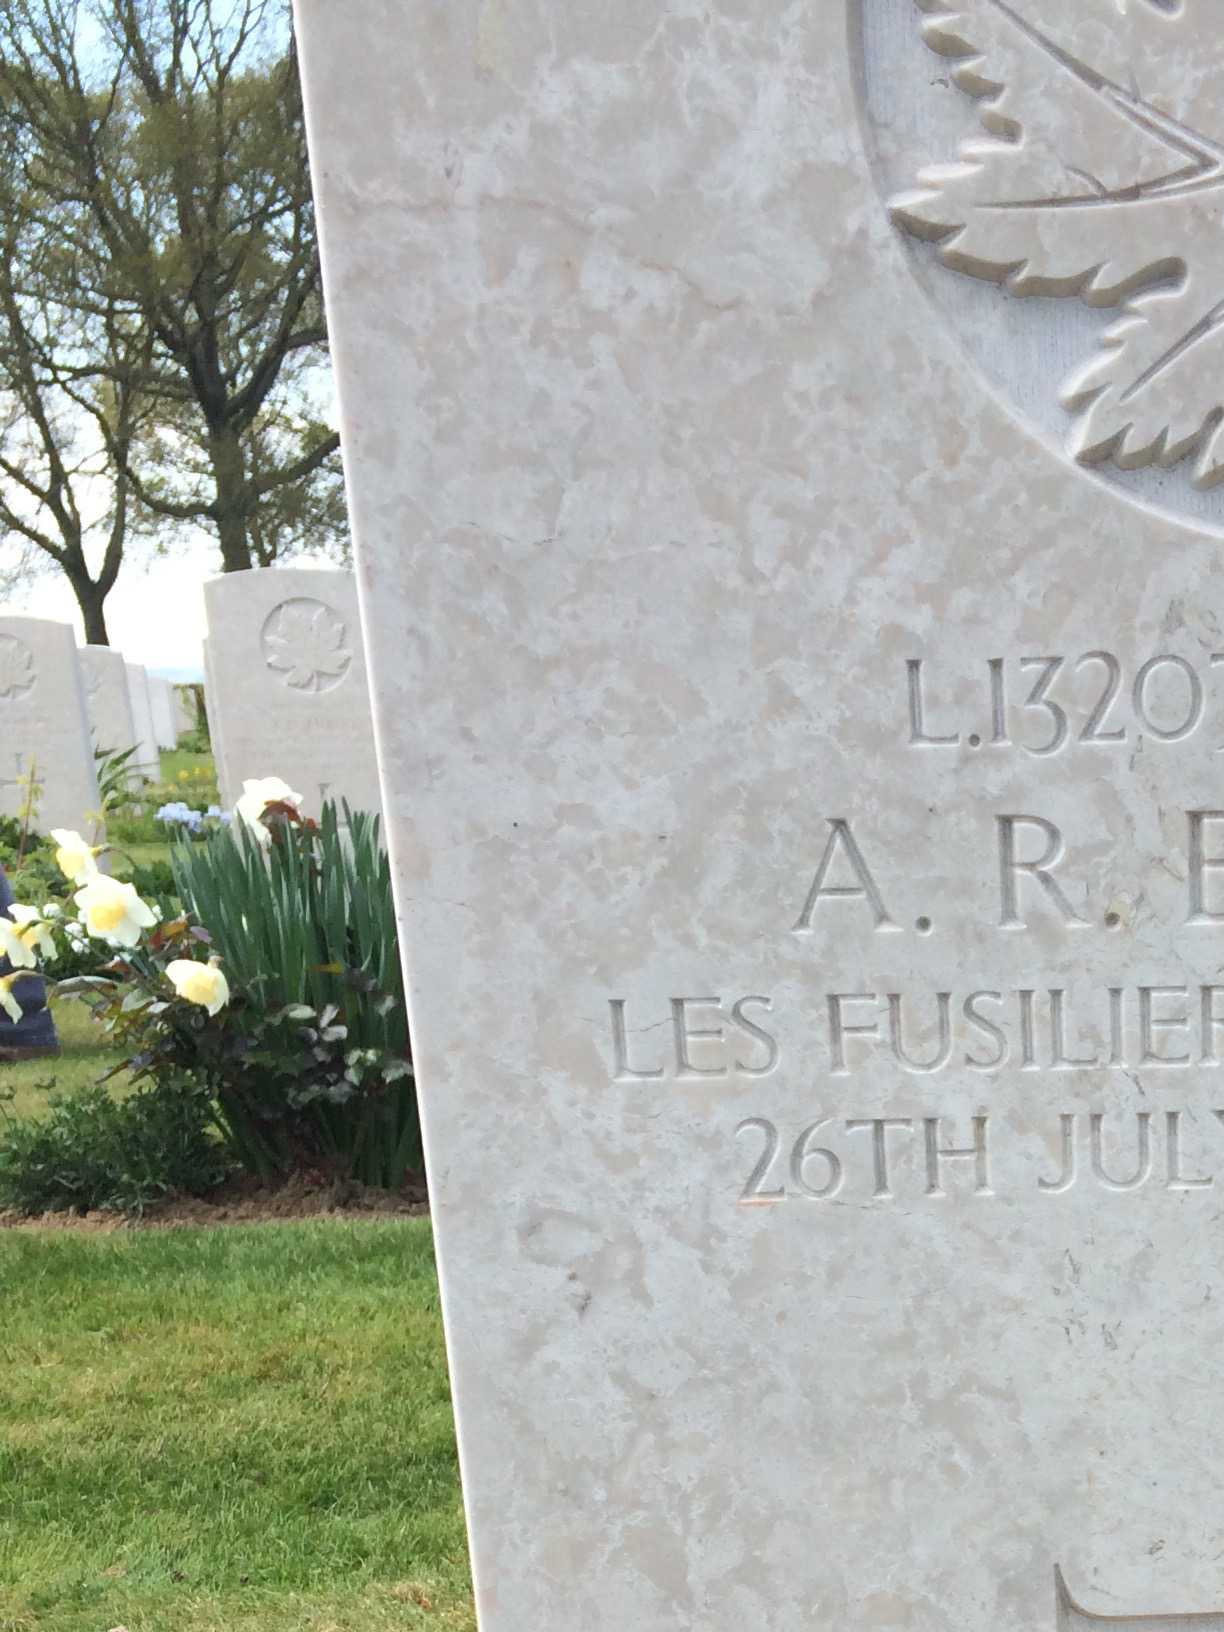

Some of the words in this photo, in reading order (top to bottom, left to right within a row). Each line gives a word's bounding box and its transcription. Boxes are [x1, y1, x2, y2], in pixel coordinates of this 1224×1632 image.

[791, 817, 933, 934] A.
[995, 812, 1122, 929] R.
[608, 994, 781, 1082] LES
[734, 1116, 997, 1204] 26TH
